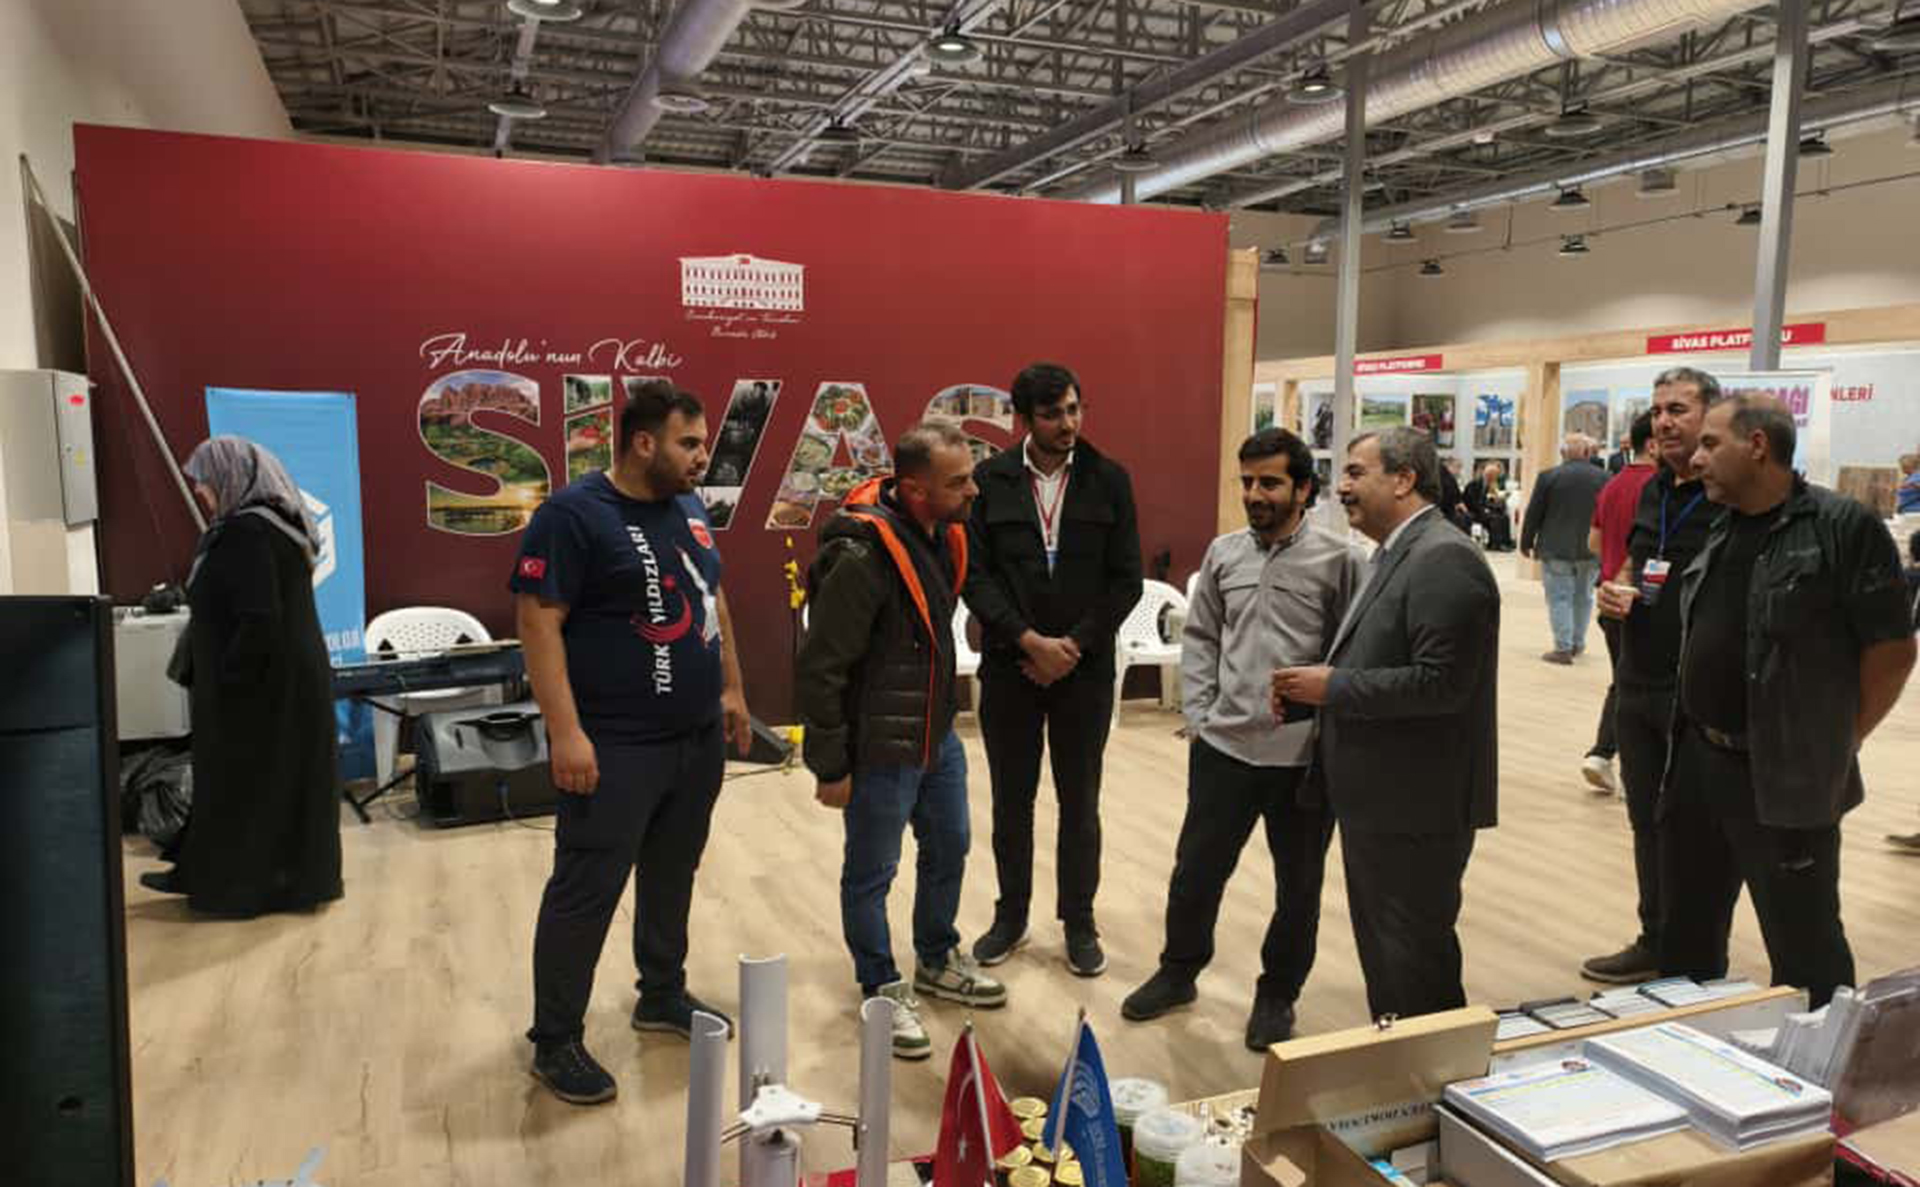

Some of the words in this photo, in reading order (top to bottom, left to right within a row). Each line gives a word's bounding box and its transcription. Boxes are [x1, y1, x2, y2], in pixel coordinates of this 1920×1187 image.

[419, 332, 581, 370] Anadolu'nun
[588, 338, 682, 373] Kalbi
[1672, 334, 1708, 350] SİVAS
[1709, 329, 1793, 348] PLATFU
[626, 525, 668, 624] YILDIZLARI
[652, 644, 673, 694] TÜRK
